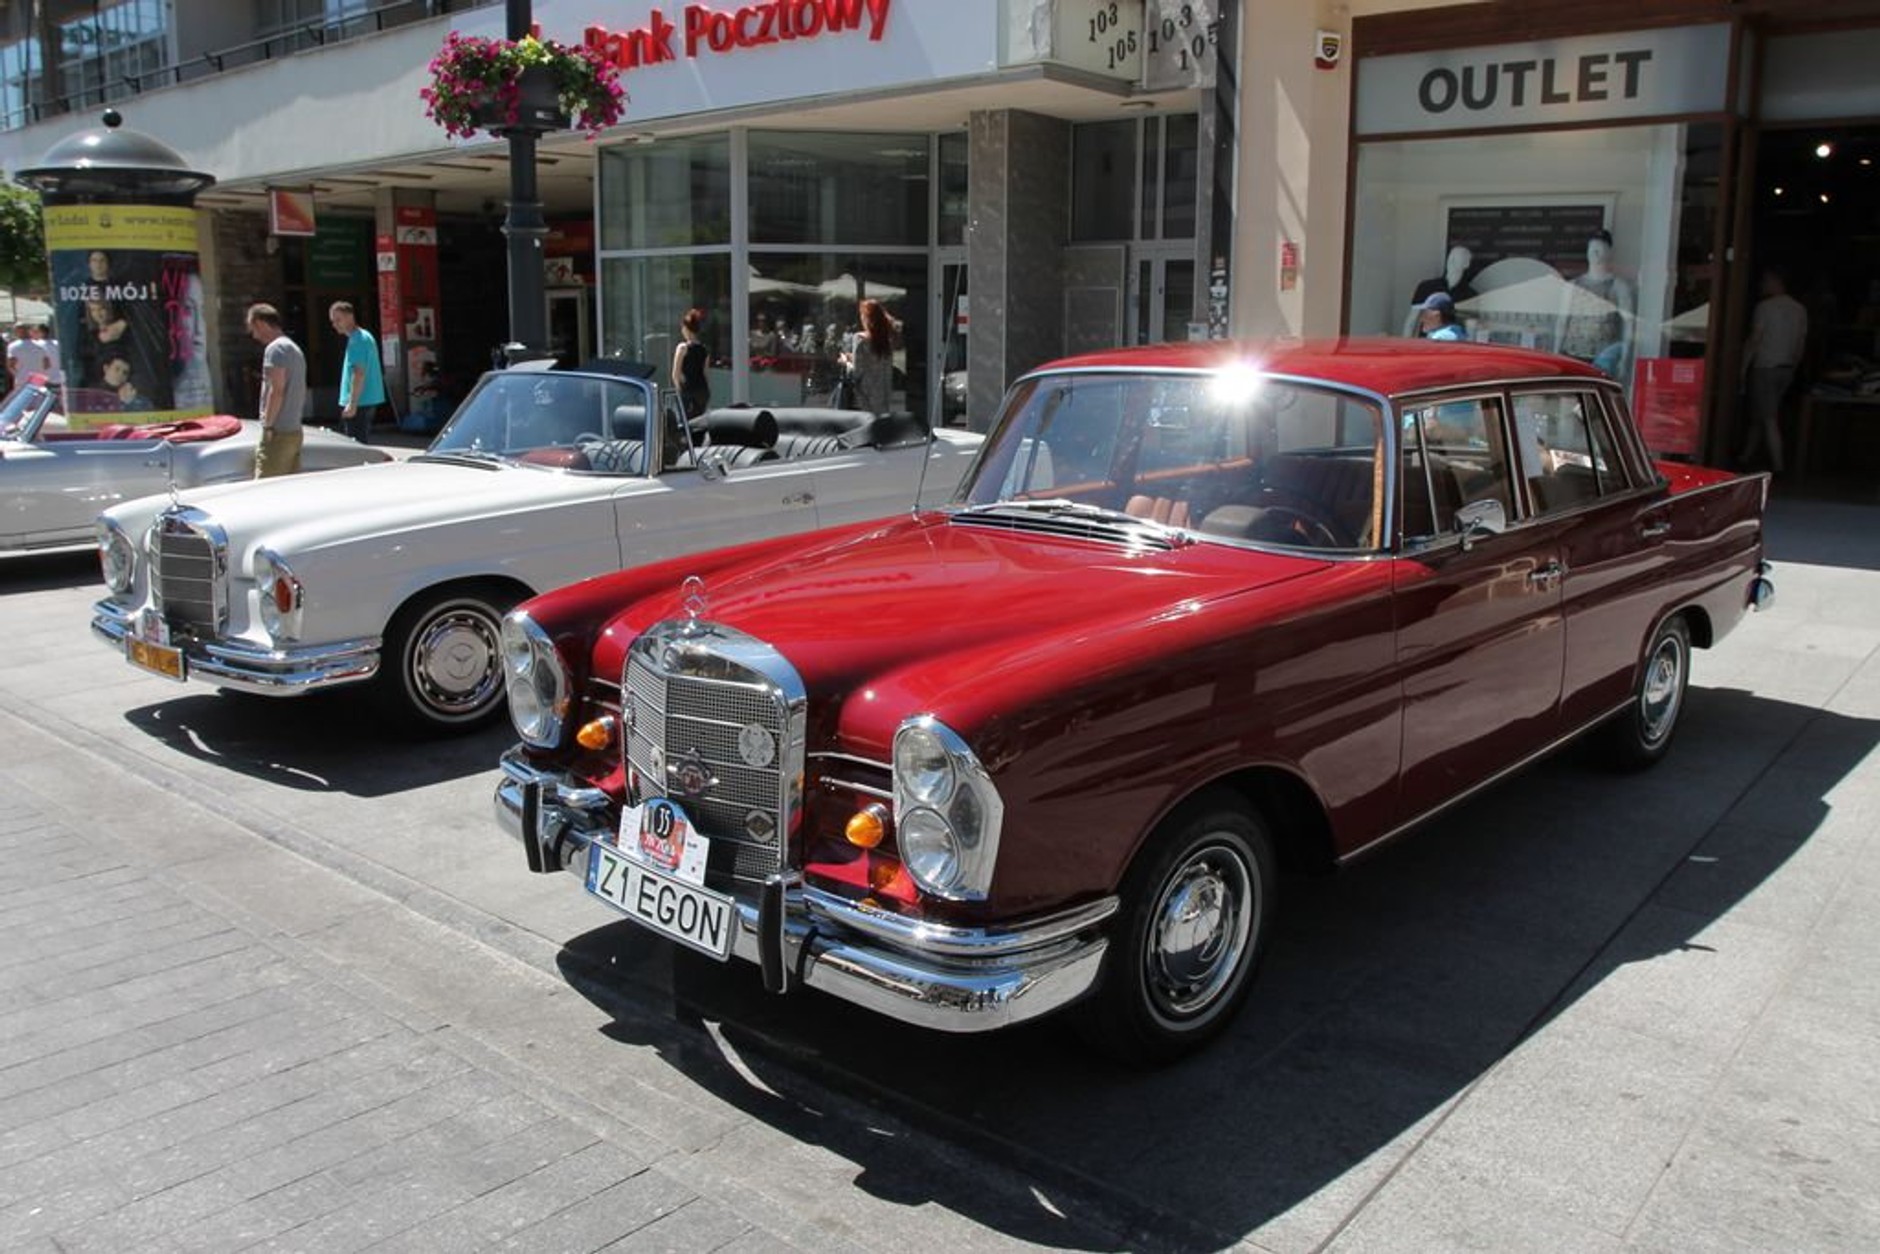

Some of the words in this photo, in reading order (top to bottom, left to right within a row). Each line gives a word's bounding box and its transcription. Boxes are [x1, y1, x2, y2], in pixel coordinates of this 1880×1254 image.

[585, 9, 675, 70] Bank
[685, 0, 890, 57] Pocztowy
[1090, 3, 1117, 42] 103
[1150, 4, 1191, 53] 103
[1108, 31, 1136, 69] 105
[1419, 50, 1653, 113] OUTLET
[60, 282, 101, 302] BOŻE
[601, 855, 629, 904] Z1
[637, 875, 723, 946] EGON
